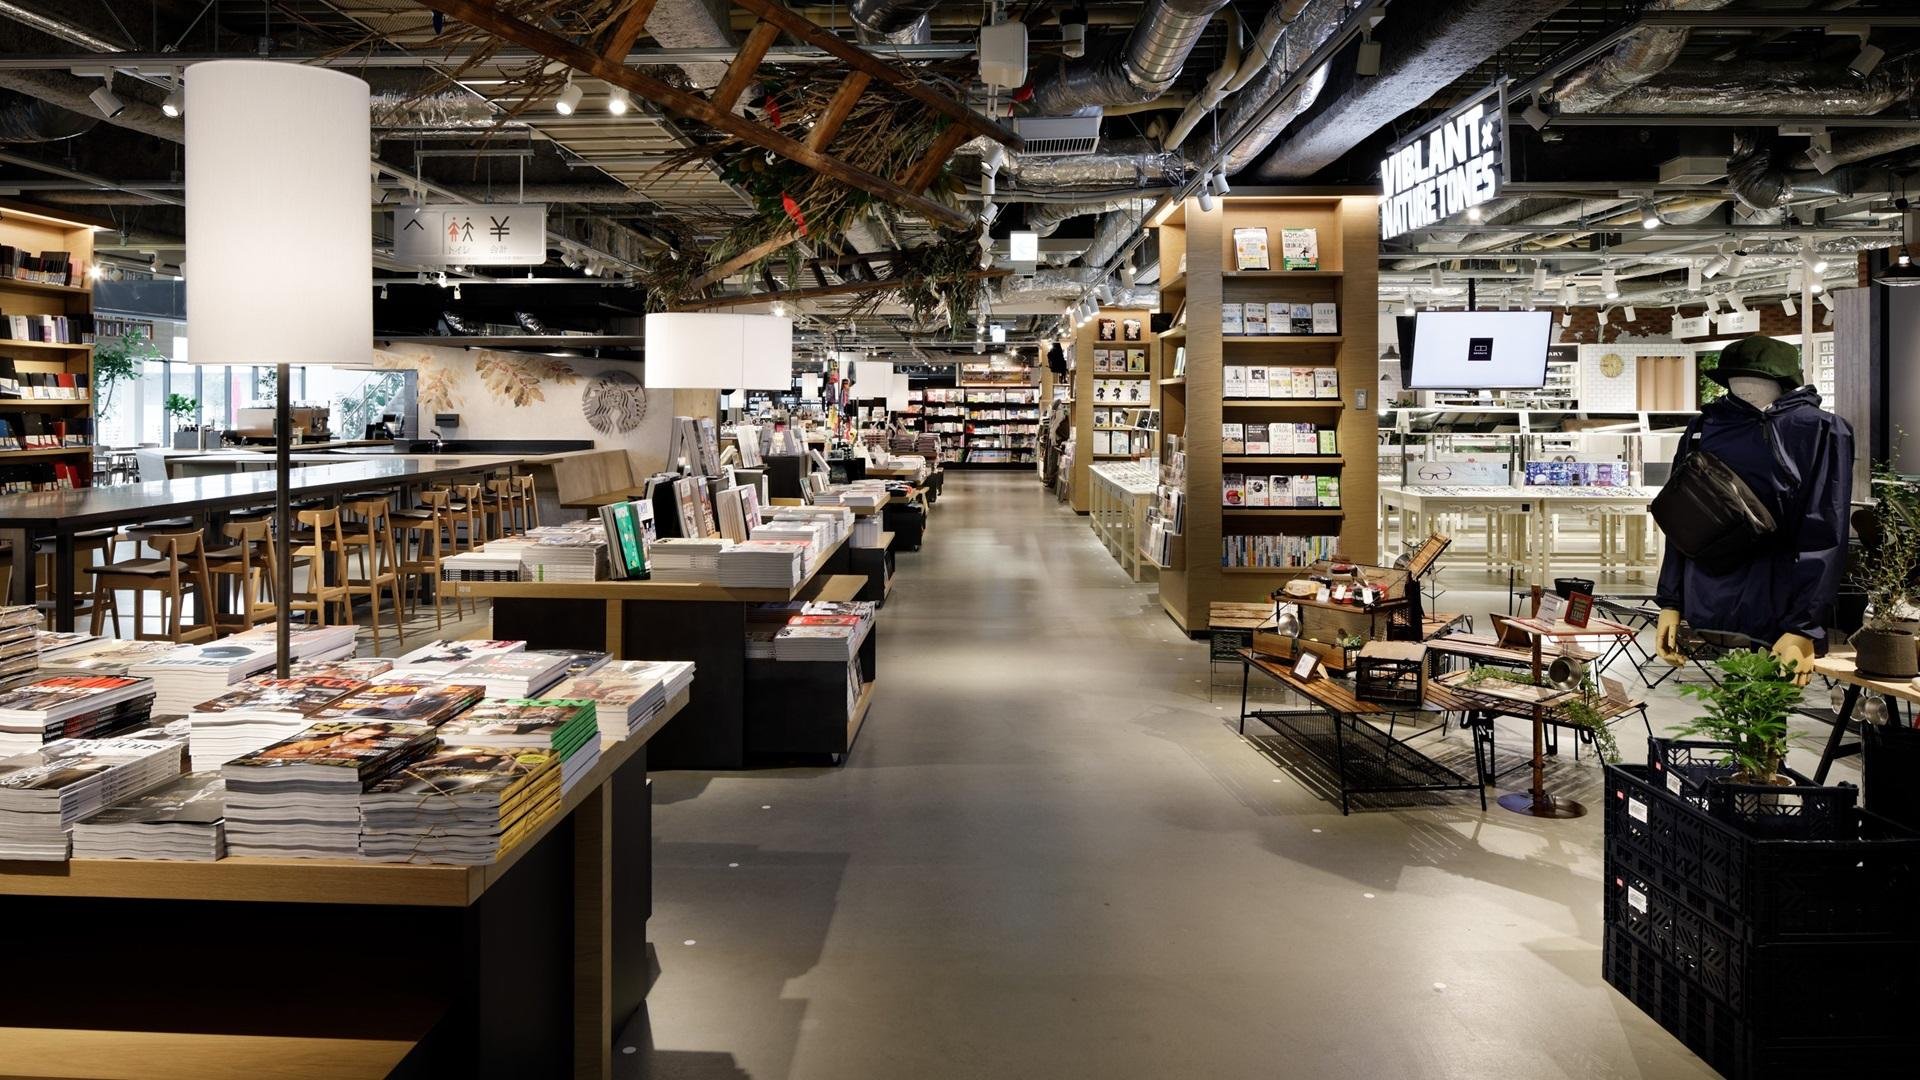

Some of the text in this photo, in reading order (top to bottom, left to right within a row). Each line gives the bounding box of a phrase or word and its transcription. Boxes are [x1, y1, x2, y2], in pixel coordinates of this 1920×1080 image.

[1381, 104, 1484, 197] VIBLANT
[1382, 151, 1495, 240] NATURE TONES
